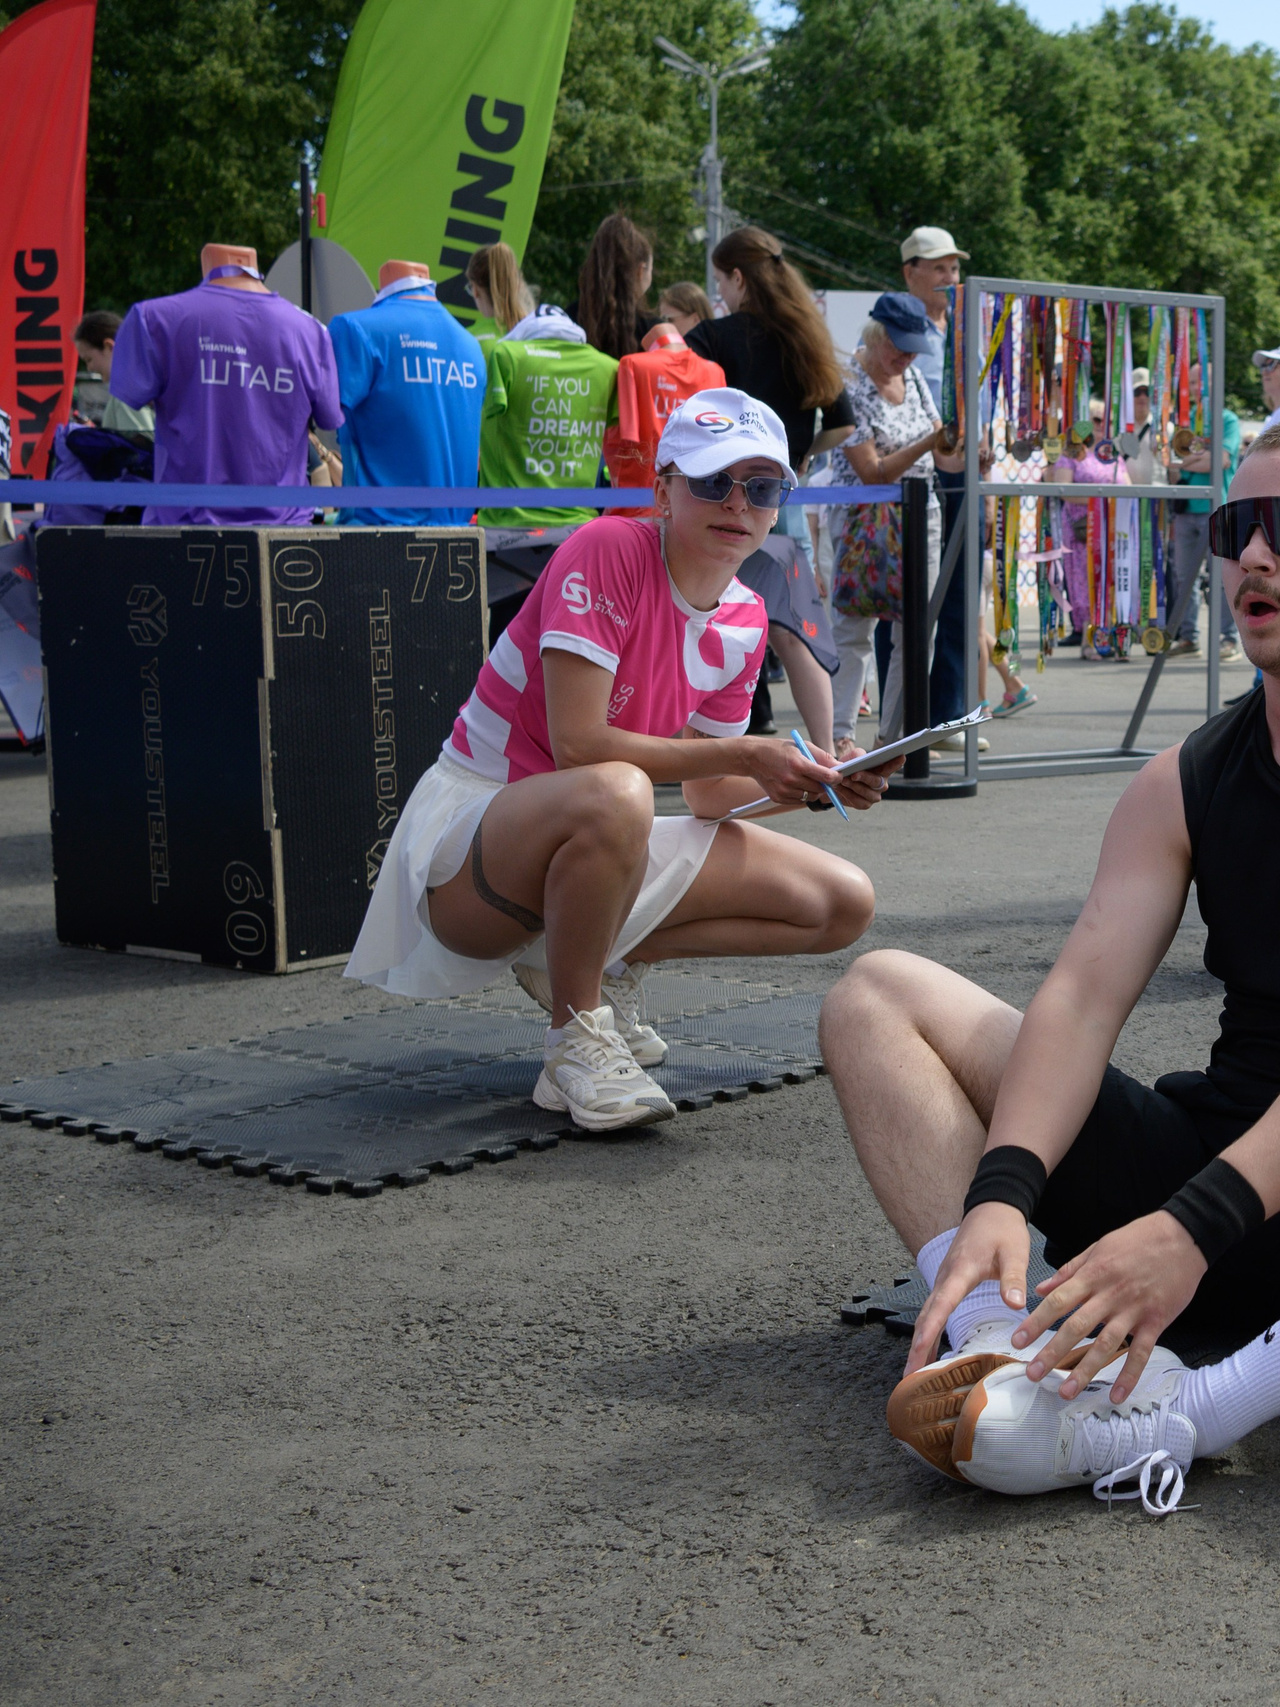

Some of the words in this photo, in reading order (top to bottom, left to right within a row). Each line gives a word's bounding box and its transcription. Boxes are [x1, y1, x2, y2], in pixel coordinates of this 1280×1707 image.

[431, 93, 526, 328] NING
[200, 343, 247, 355] TRIATHLON
[200, 358, 294, 394] ШТАБ
[402, 356, 477, 389] ШТАБ
[554, 377, 590, 396] YOU
[531, 397, 571, 416] CAN
[739, 411, 759, 420] GYM
[528, 418, 592, 437] DREAM
[527, 437, 570, 457] YOU
[573, 441, 603, 458] CAN
[525, 457, 555, 477] DO
[187, 544, 251, 608] 75
[406, 543, 476, 602] 75
[273, 546, 327, 640] 50
[369, 589, 400, 830] YOUSTEEL
[140, 657, 170, 904] YOUSTEEL
[223, 860, 267, 956] 60
